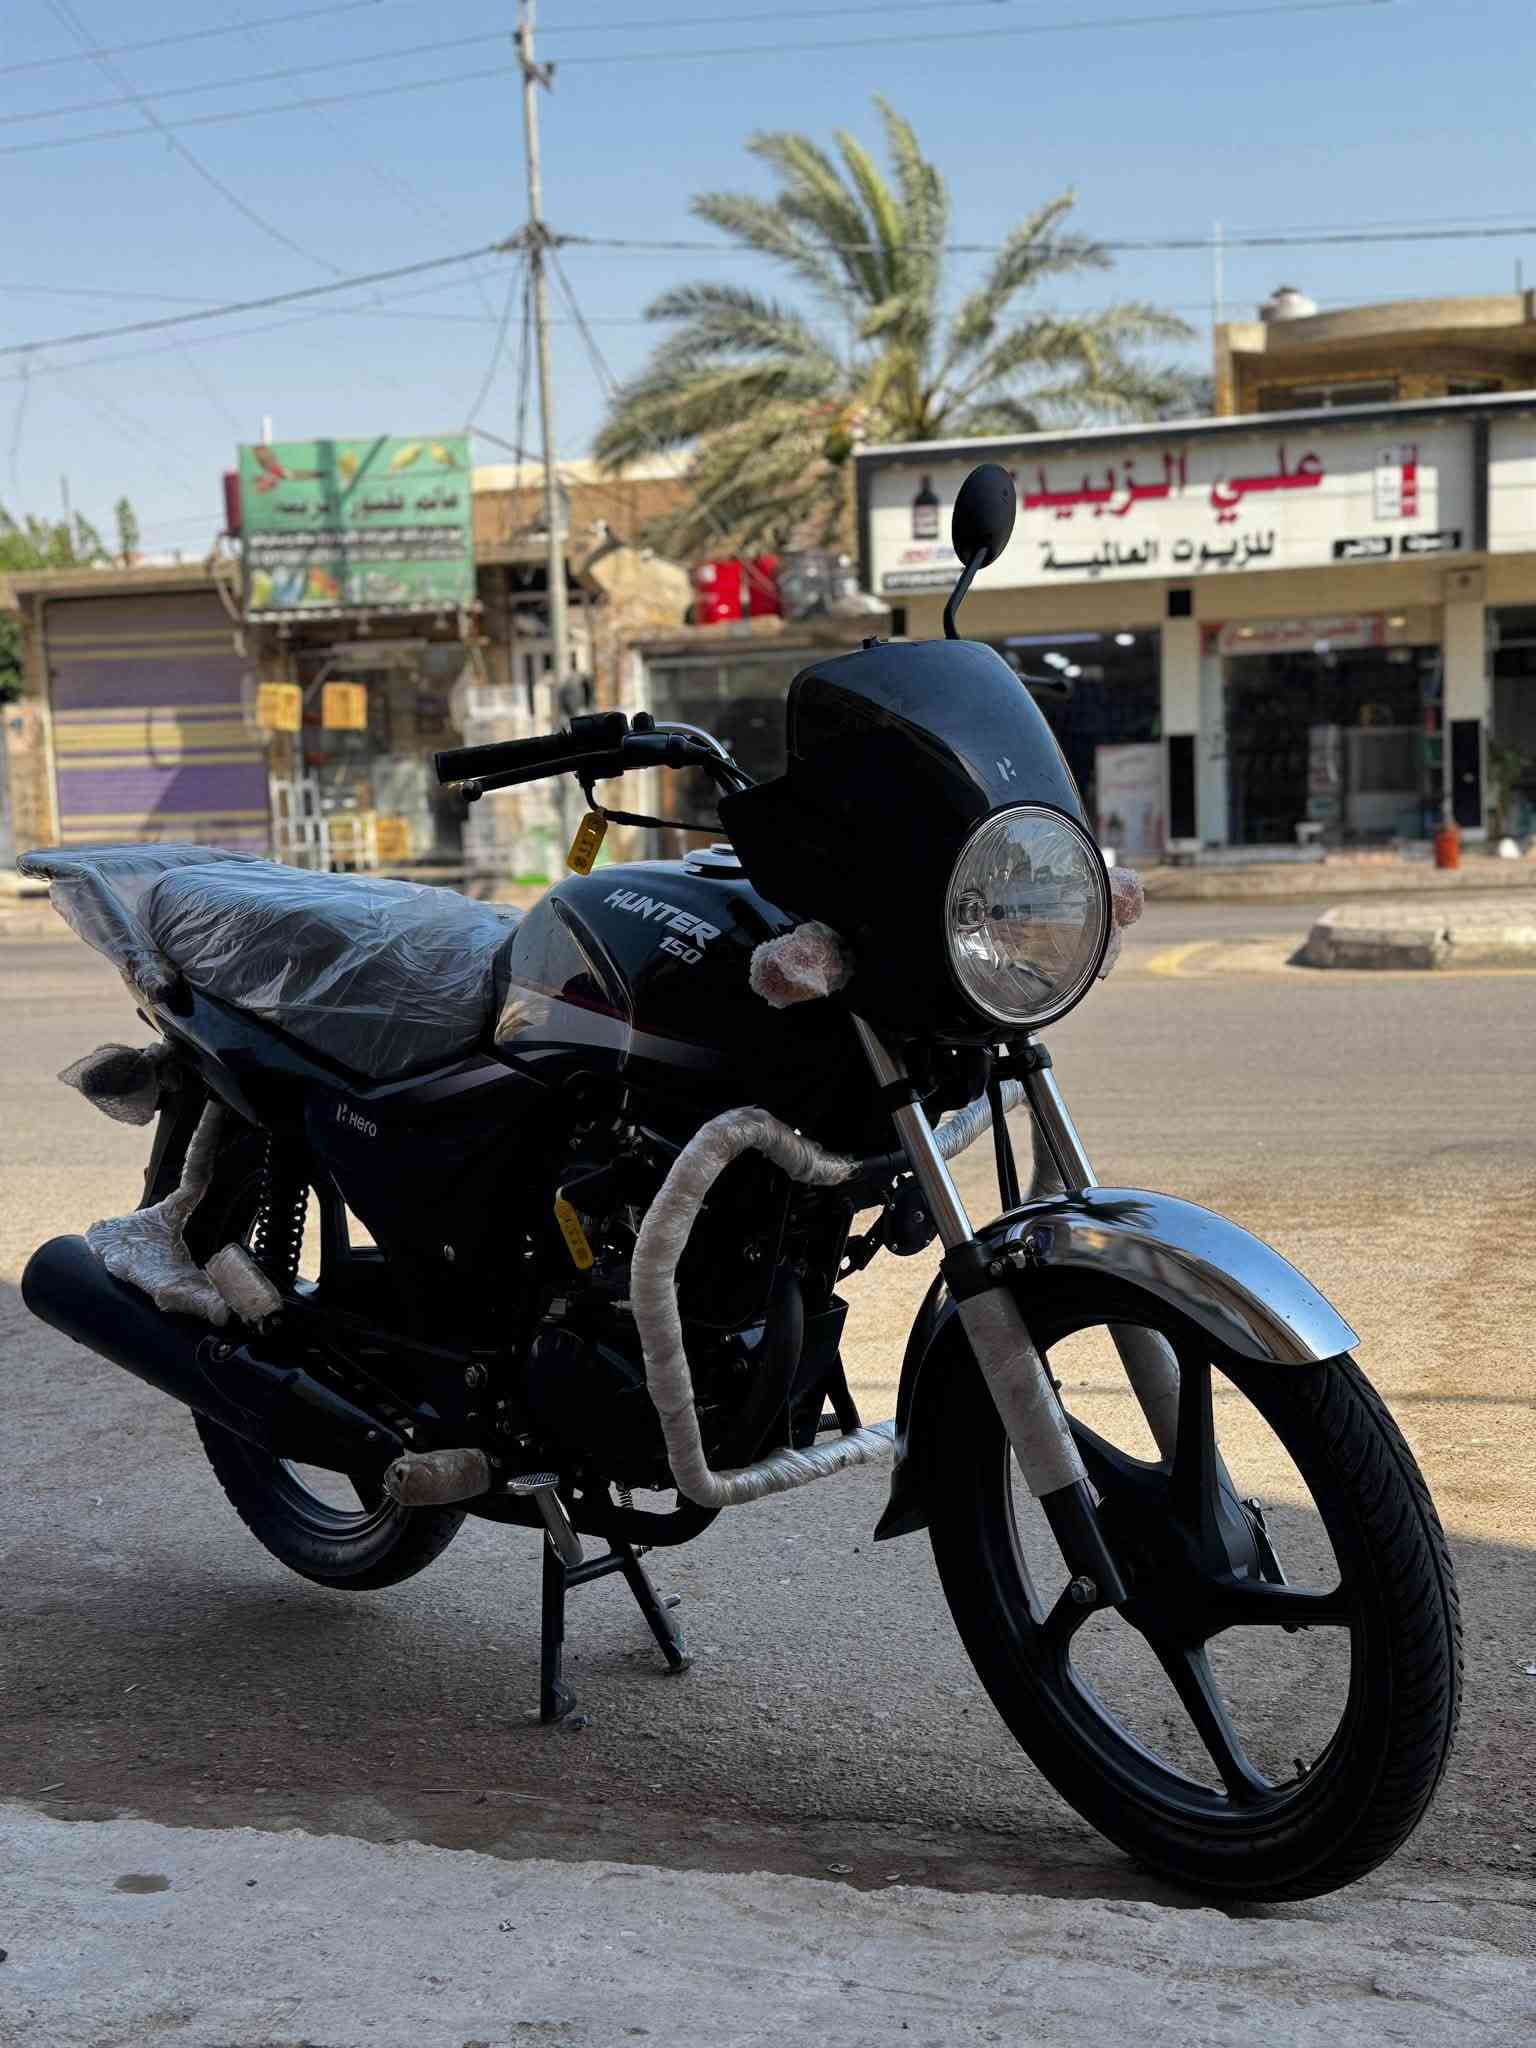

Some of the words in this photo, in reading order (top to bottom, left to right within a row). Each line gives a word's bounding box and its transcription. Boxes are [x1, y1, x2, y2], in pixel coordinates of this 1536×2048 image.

[1010, 446, 1188, 518] الزبيد
[1210, 443, 1325, 524] علي
[1039, 537, 1160, 576] العالمية
[1172, 529, 1276, 570] للزيوت
[602, 887, 722, 951] HUNTER
[659, 936, 703, 965] 150
[348, 1111, 377, 1137] Hero
